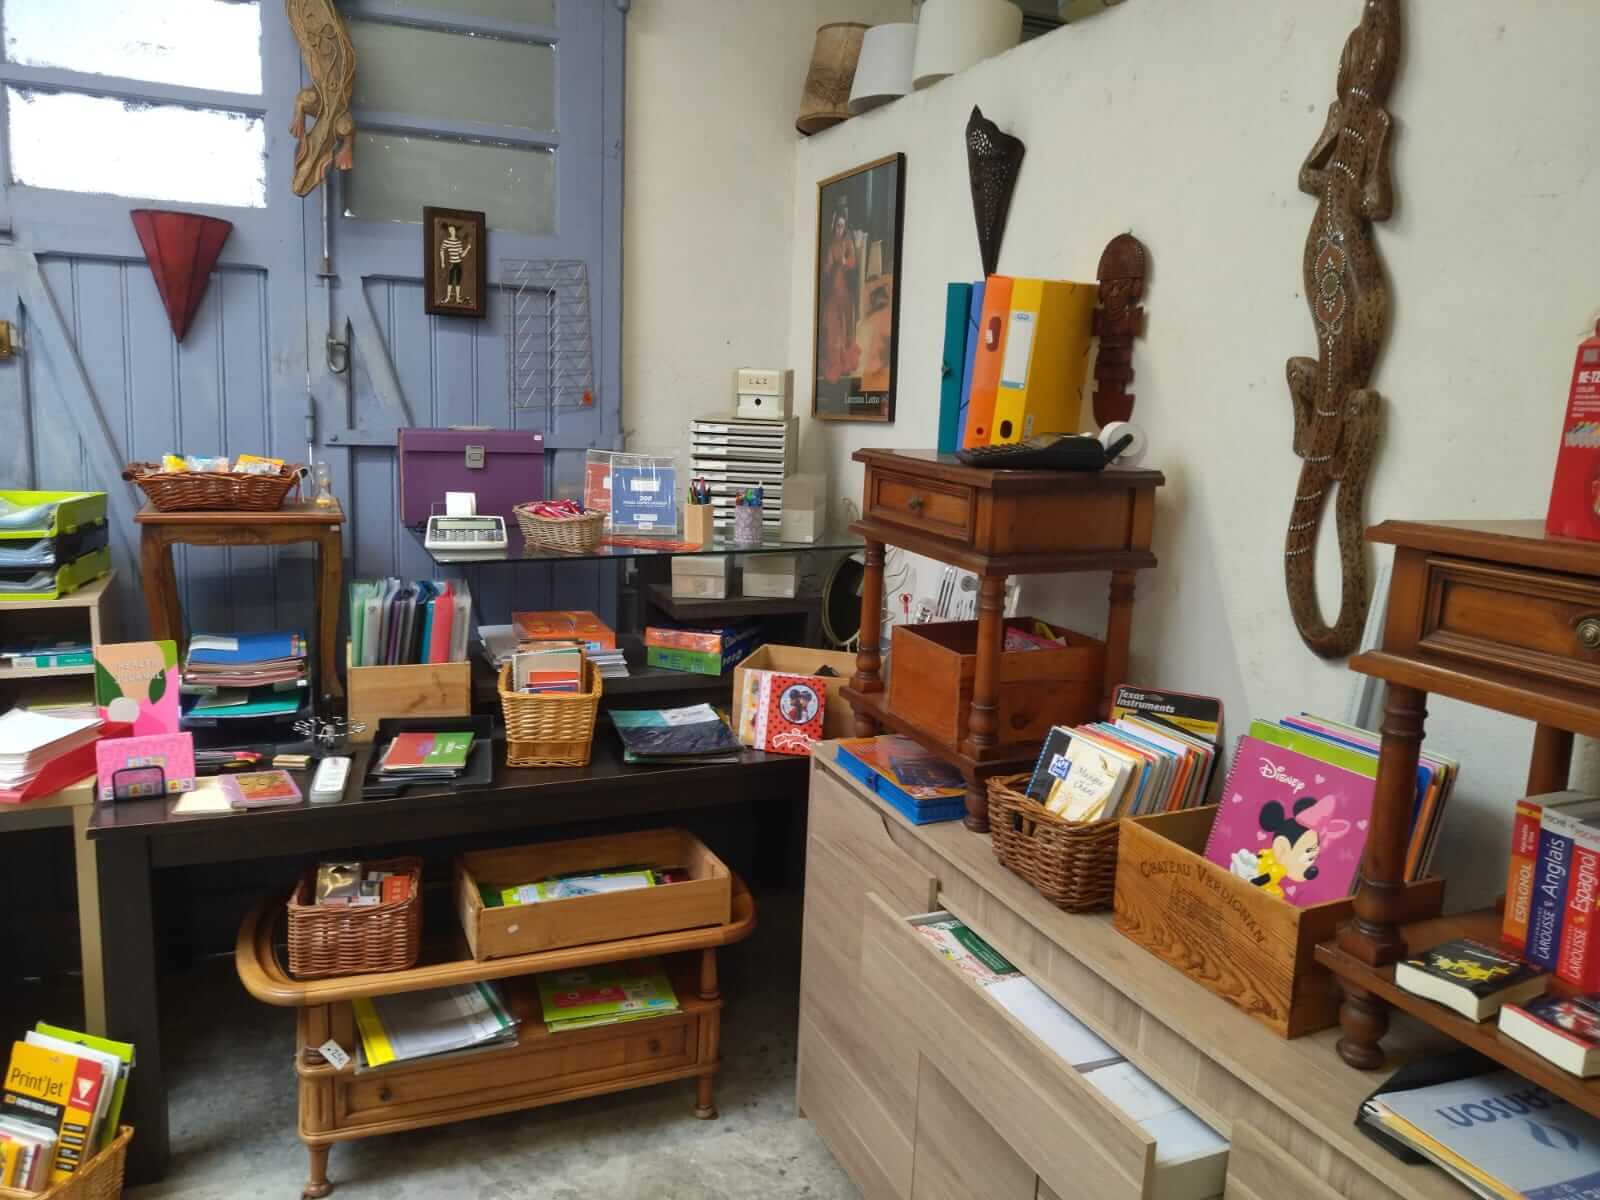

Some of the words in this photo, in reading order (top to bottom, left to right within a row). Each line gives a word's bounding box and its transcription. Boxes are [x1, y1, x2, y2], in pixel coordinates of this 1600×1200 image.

[1117, 696, 1175, 713] Instruments
[1119, 689, 1145, 700] Texas
[1515, 863, 1532, 924] ESPAGNOL
[1541, 838, 1566, 900] Anglais
[1570, 852, 1598, 913] Espagnol
[1538, 911, 1556, 960] LAROUSSE
[1568, 927, 1587, 980] LAROUSSE
